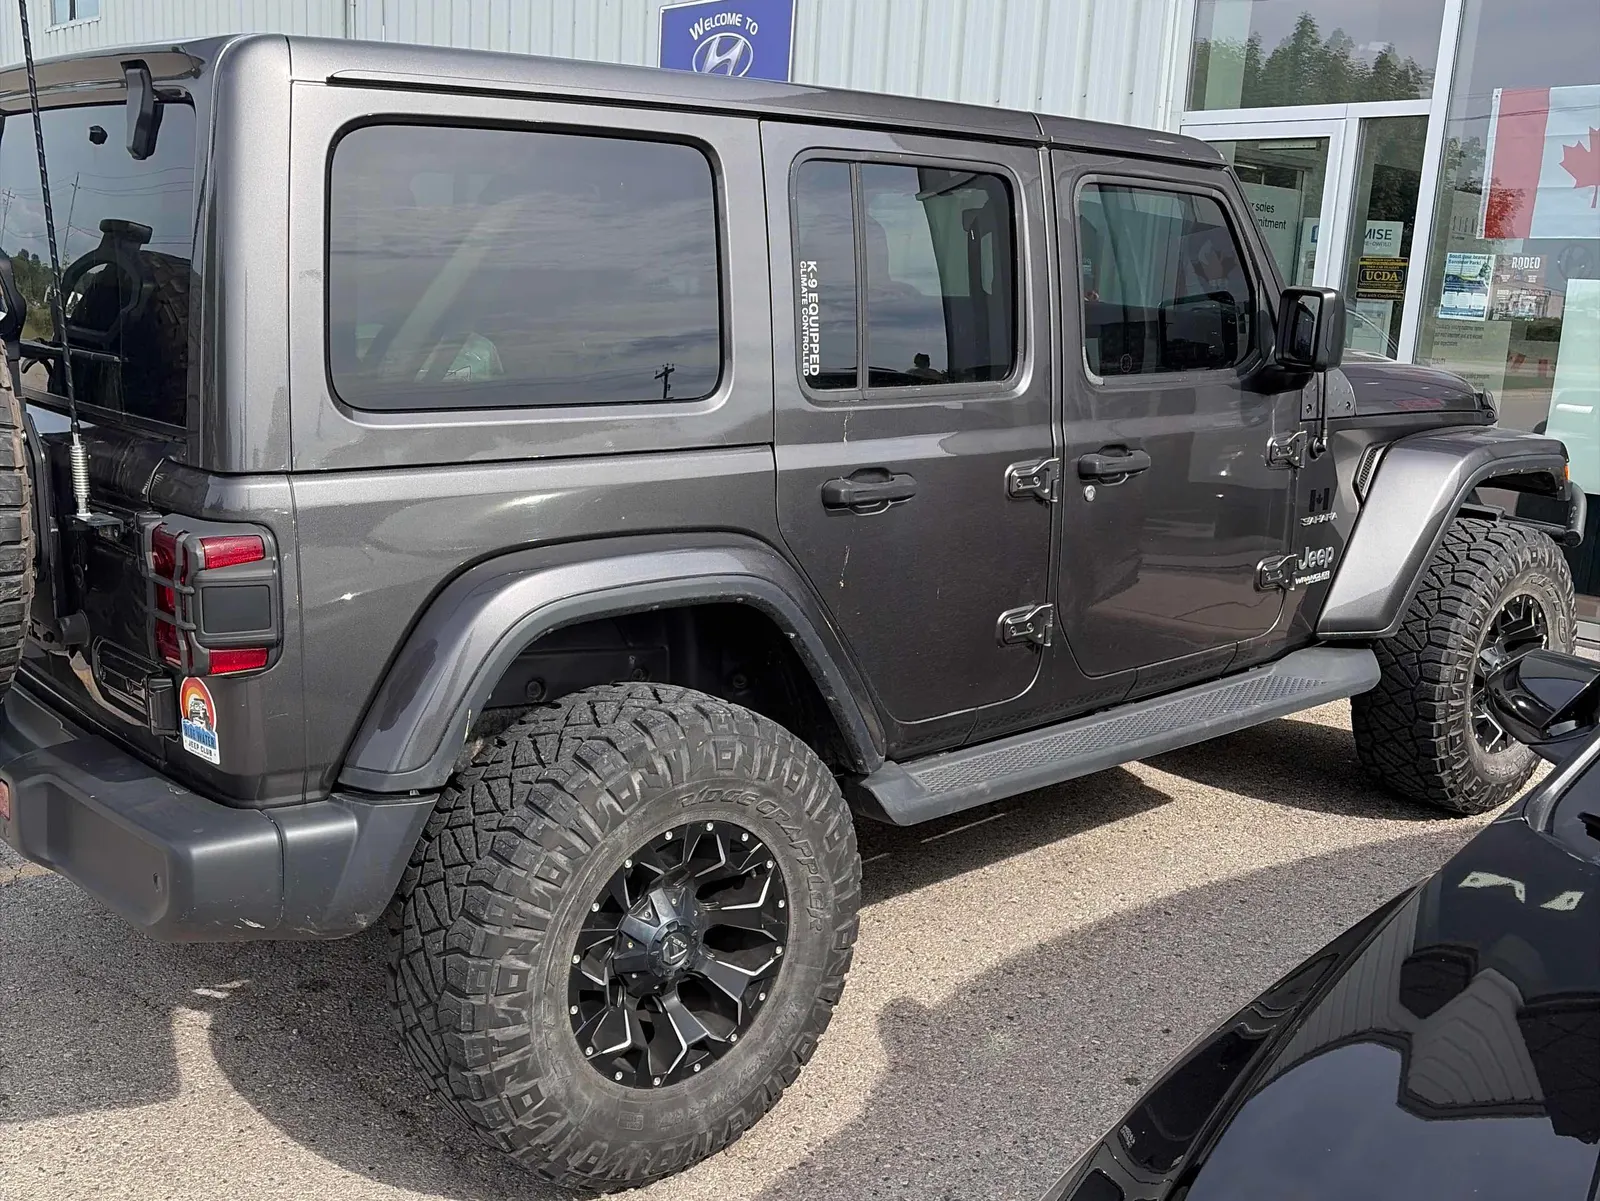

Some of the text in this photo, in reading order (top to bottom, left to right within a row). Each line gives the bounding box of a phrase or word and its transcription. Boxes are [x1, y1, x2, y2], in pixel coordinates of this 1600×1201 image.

[689, 12, 759, 41] WELCOME TO
[1255, 202, 1275, 213] sales
[1511, 256, 1541, 269] RODEO
[1366, 271, 1398, 281] UCDA
[800, 260, 810, 377] CLIMATE CONTROLLED
[807, 260, 820, 377] K-9 EQUIPPED
[1300, 511, 1338, 526] SAHARA
[1298, 546, 1335, 570] Jeep
[188, 739, 200, 750] JEEP
[200, 745, 213, 757] CLUB
[755, 799, 825, 933] GRAPPLER
